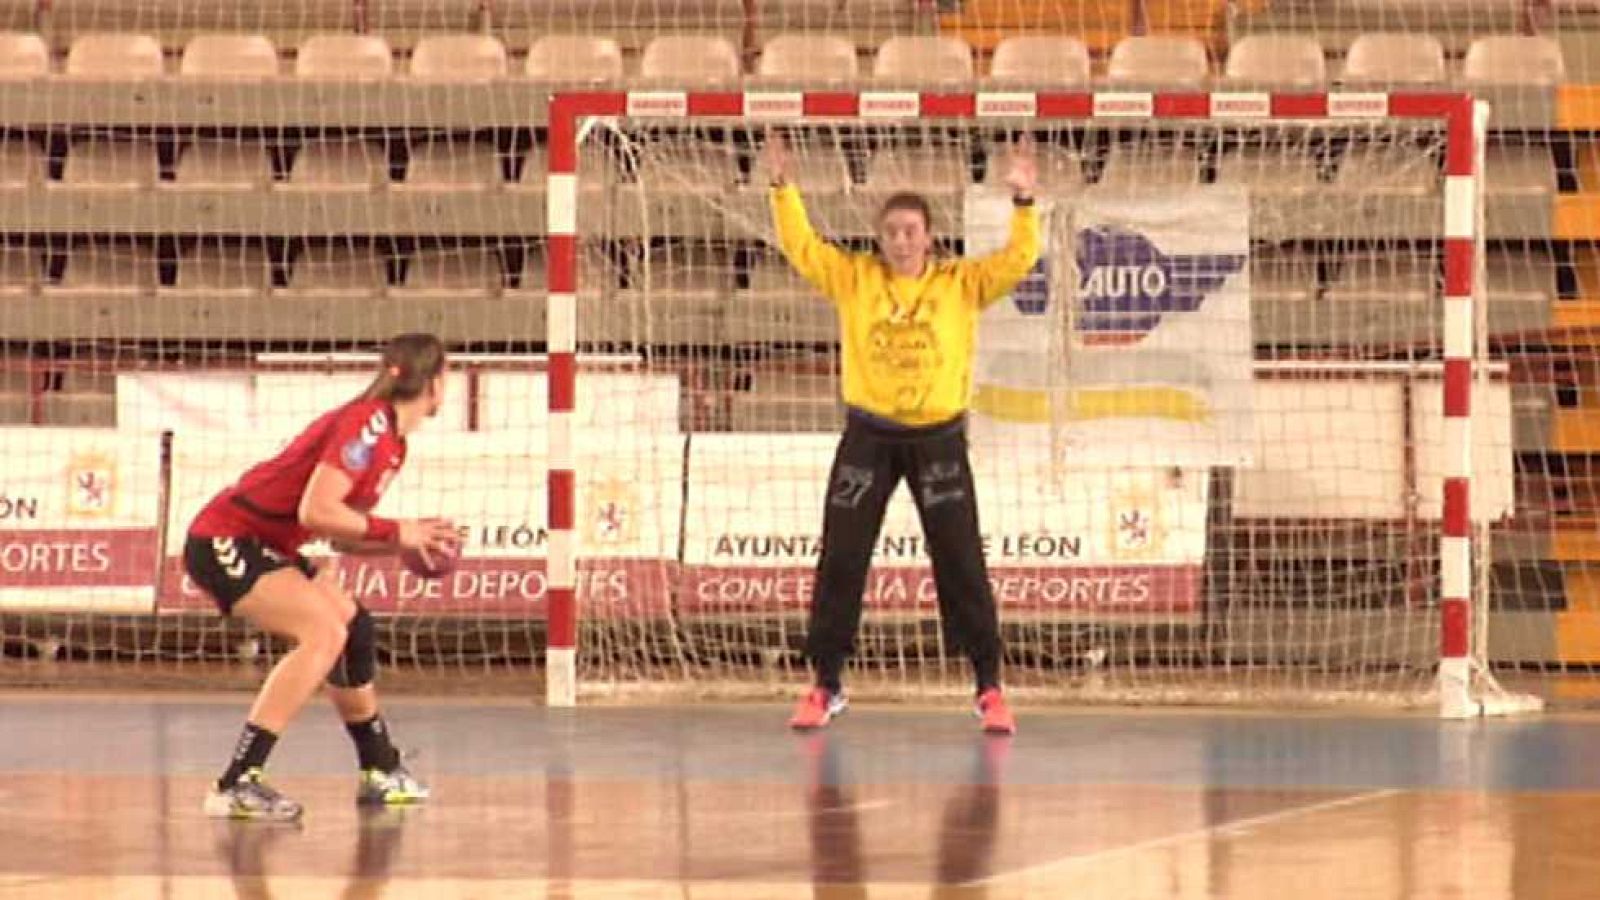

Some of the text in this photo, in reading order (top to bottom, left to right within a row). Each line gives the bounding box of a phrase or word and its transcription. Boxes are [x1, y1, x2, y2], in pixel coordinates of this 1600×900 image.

[1085, 266, 1166, 298] AUTO
[1002, 528, 1081, 557] LEÓN
[453, 569, 628, 601] DEPOTES
